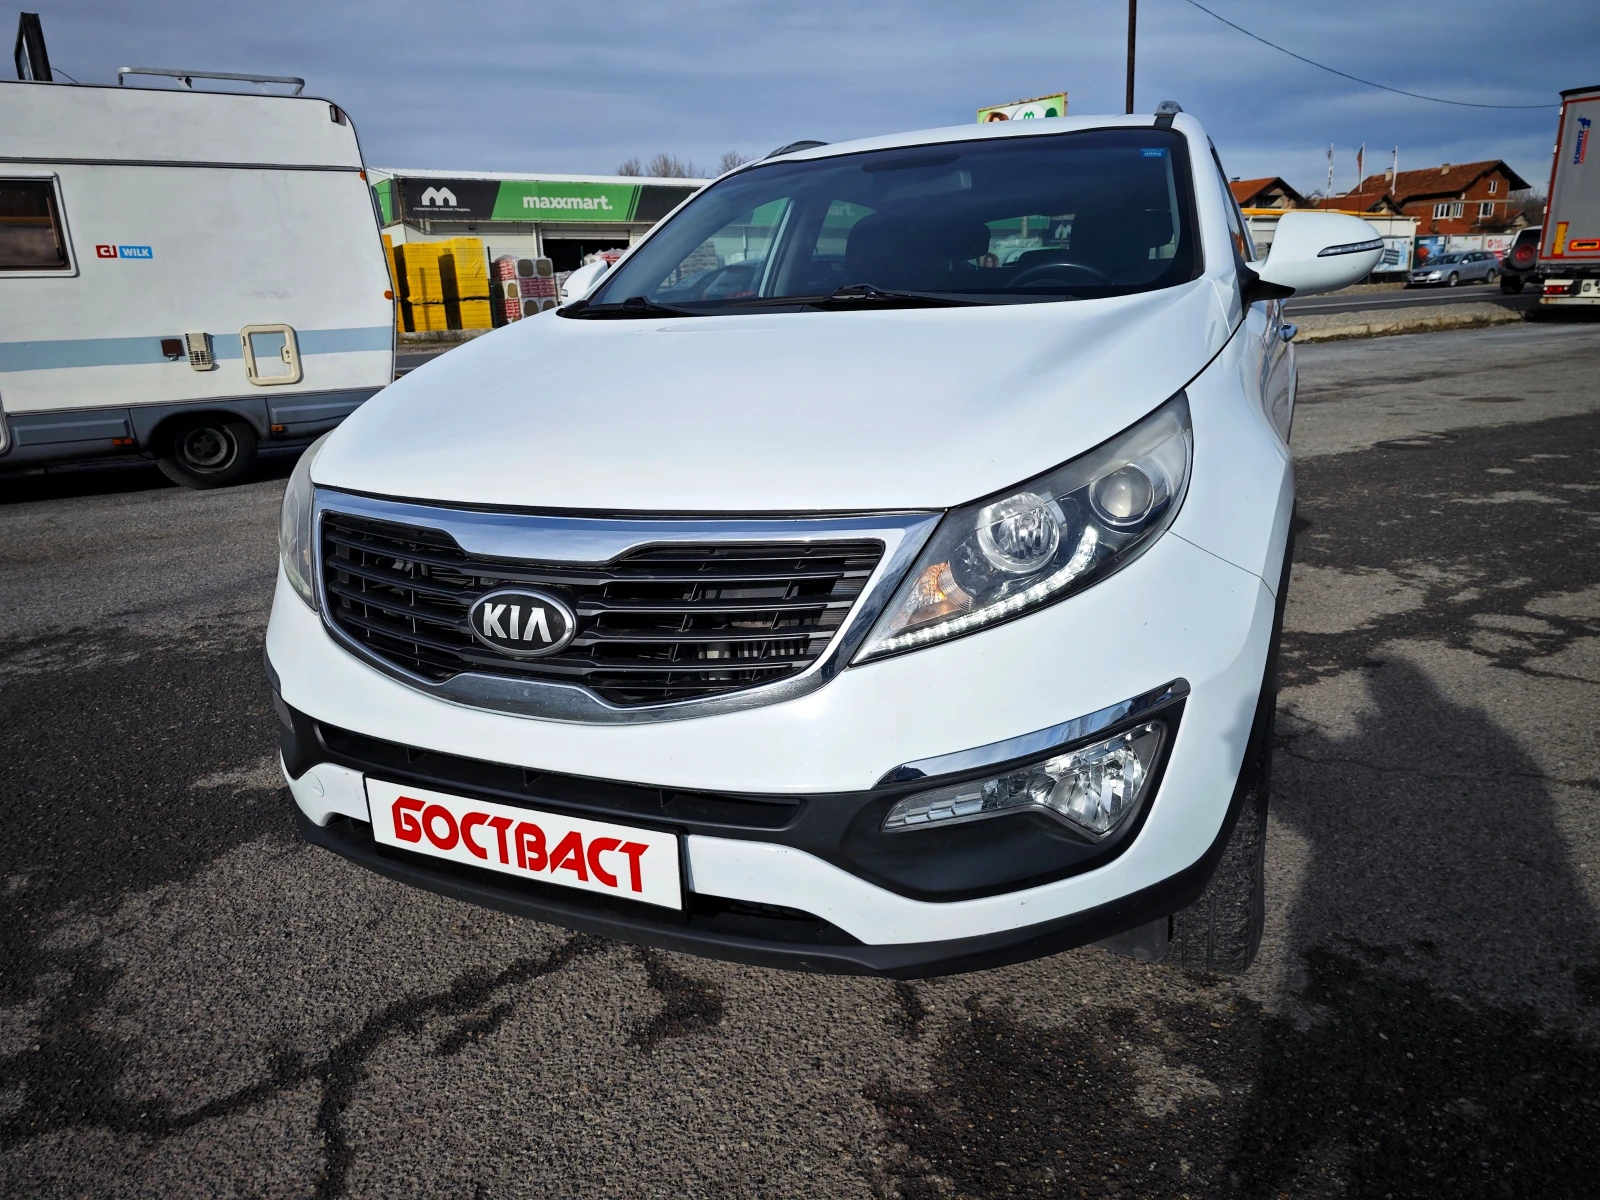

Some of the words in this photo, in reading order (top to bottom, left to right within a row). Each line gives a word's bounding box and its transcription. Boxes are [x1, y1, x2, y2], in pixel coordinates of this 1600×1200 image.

[1574, 130, 1584, 164] SCHMITZ
[522, 195, 613, 210] maxxmart.
[827, 203, 855, 216] art.
[122, 247, 150, 257] WILK
[483, 602, 553, 643] KIA
